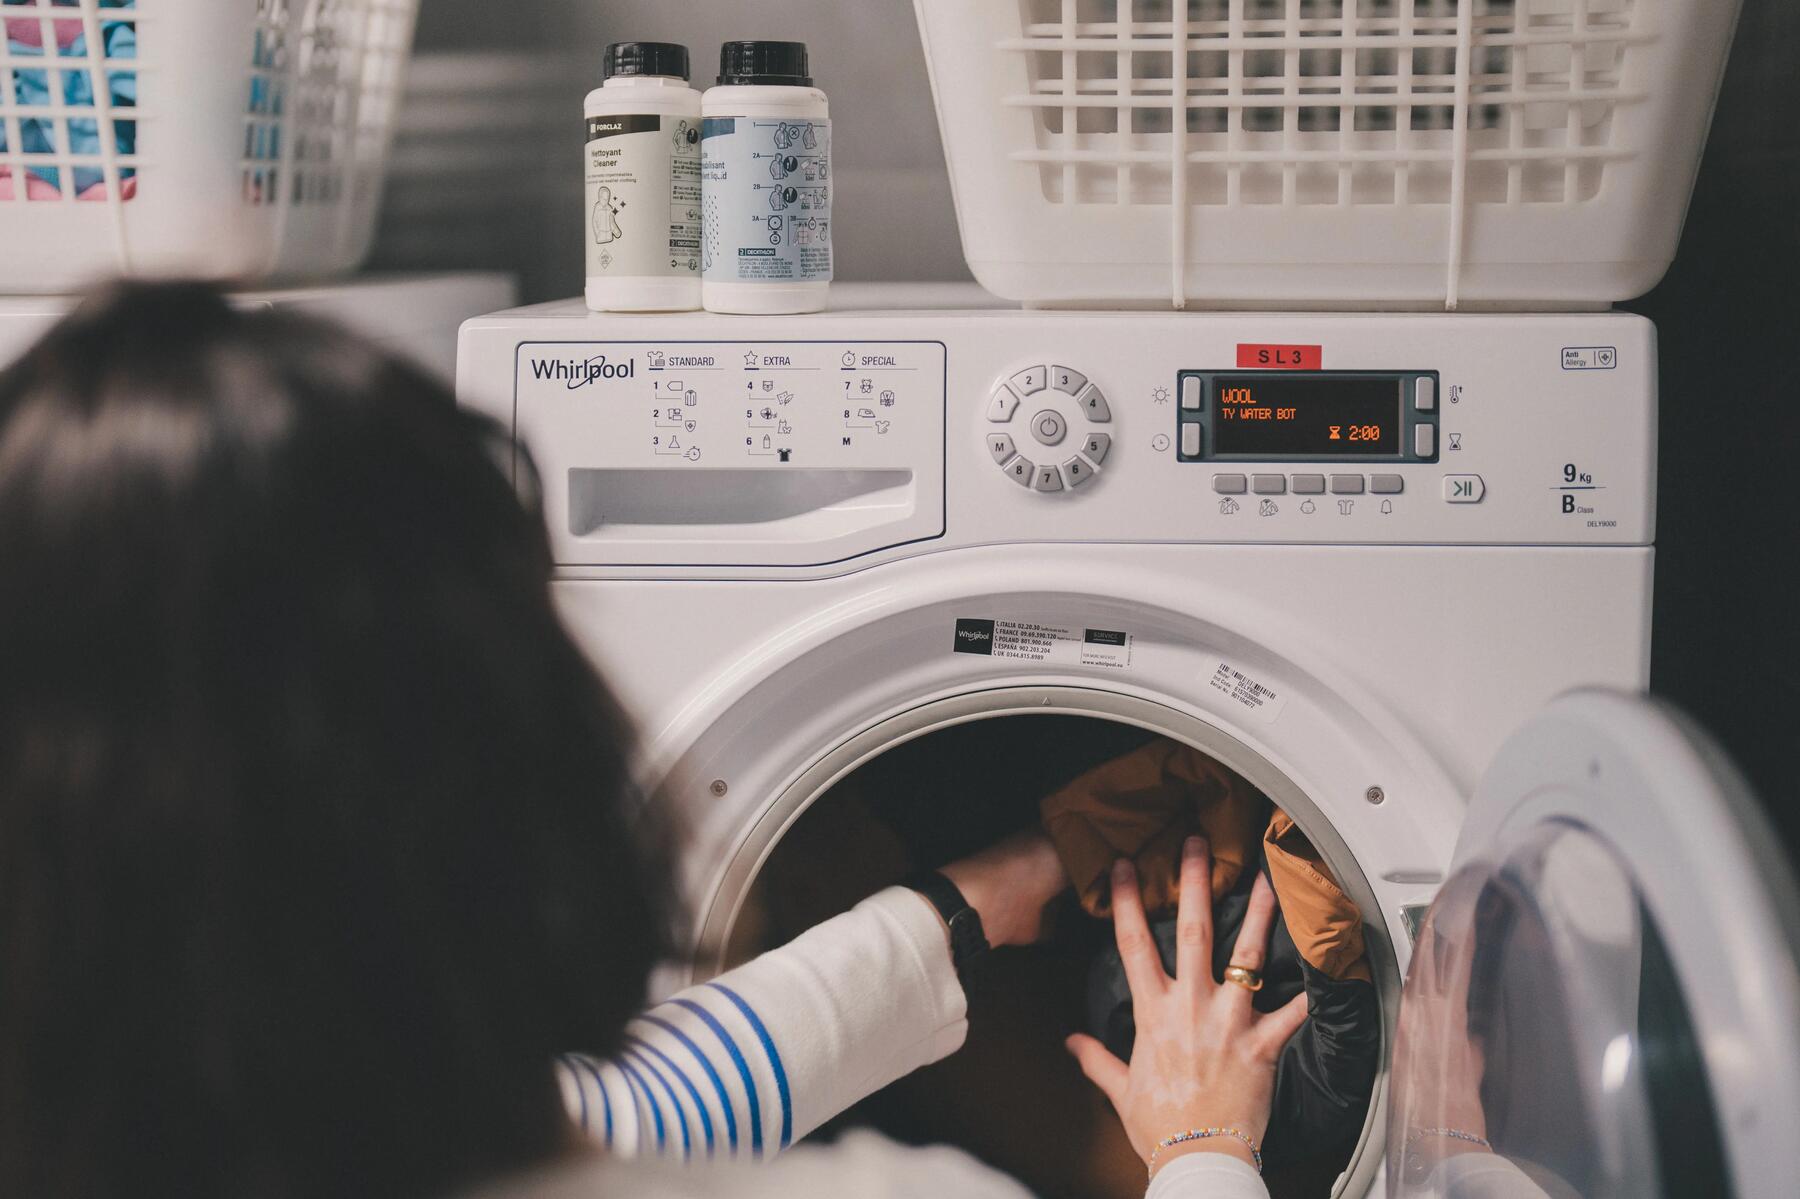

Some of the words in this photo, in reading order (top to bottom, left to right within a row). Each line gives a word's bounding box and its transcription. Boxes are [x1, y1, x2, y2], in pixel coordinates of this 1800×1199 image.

[592, 149, 622, 158] Nettoyant
[593, 160, 617, 168] Cleaner
[669, 357, 714, 366] STANDARD
[764, 356, 791, 366] EXTRA
[862, 356, 896, 366] SPECIAL
[532, 356, 634, 389] Whirlpool
[1026, 376, 1032, 384] 2
[1062, 376, 1068, 384] 3
[654, 382, 658, 390] 1
[747, 382, 753, 390] 4
[845, 382, 850, 390] 7
[1222, 388, 1256, 403] WOOL
[1000, 400, 1003, 408] 1
[1090, 399, 1096, 408] 4
[653, 410, 659, 418] 2
[747, 410, 752, 418] 5
[844, 410, 850, 418] 8
[1222, 408, 1235, 420] TY
[1240, 408, 1272, 420] WATER
[1277, 408, 1296, 420] BOT
[1349, 425, 1380, 440] 2:00
[653, 437, 659, 445] 3
[746, 437, 752, 446] 6
[843, 437, 850, 445] M
[995, 443, 1004, 452] M
[1091, 442, 1097, 450] 5
[1016, 466, 1022, 475] 8
[1072, 465, 1078, 474] 6
[1564, 464, 1576, 482] 9
[1580, 473, 1592, 484] Kg
[1044, 474, 1050, 483] 7
[1563, 495, 1575, 513] B
[959, 630, 989, 641] Whirlpool
